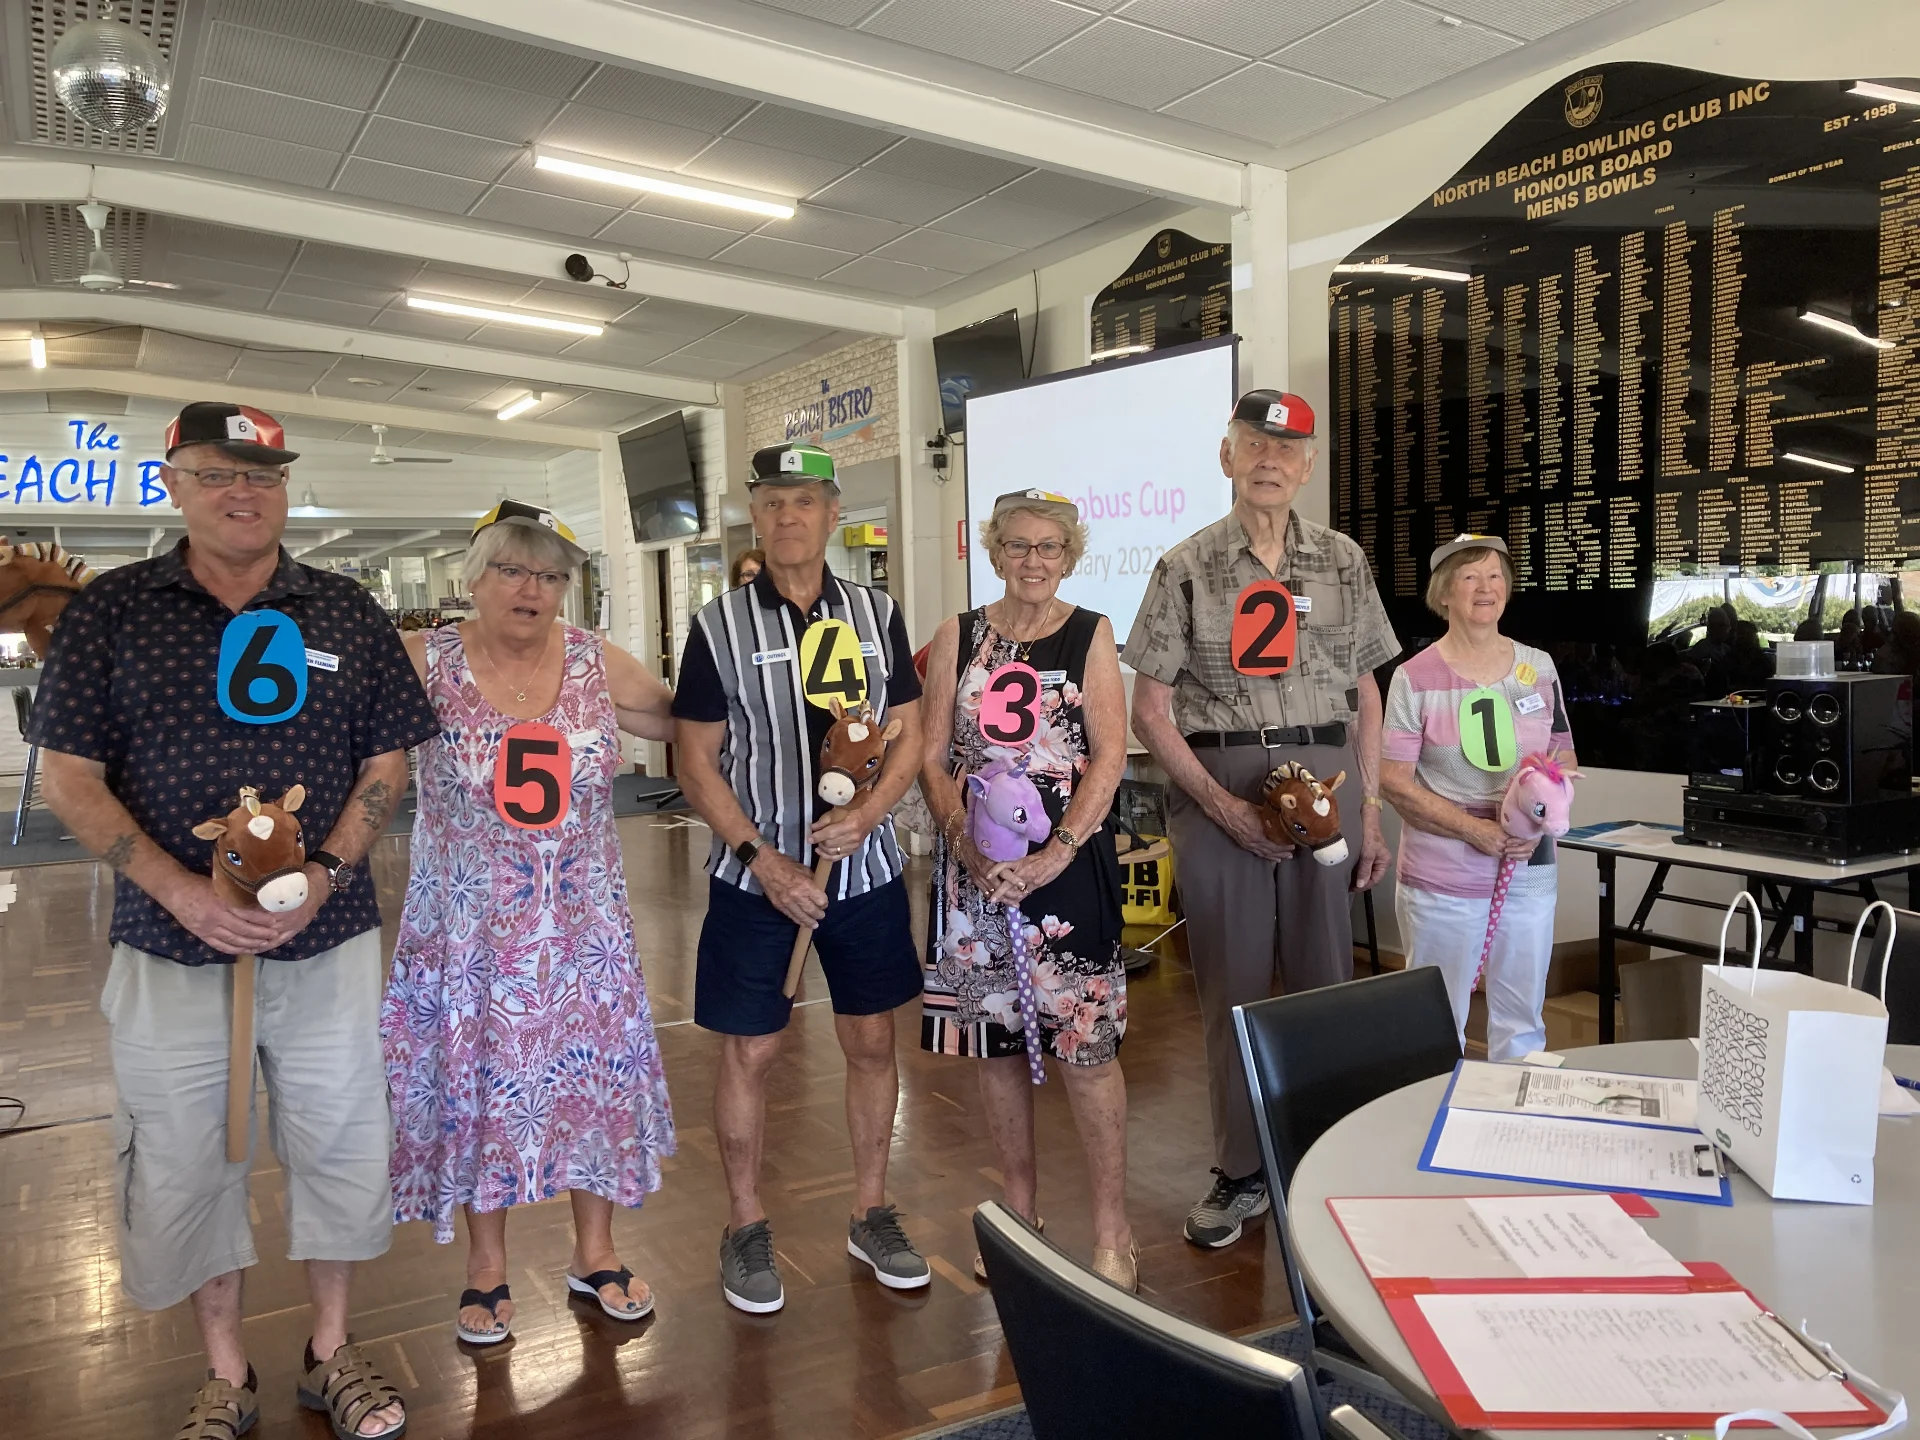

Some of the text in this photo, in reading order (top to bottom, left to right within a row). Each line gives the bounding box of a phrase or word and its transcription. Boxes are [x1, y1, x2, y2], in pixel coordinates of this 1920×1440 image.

[1823, 115, 1851, 133] EST
[1863, 102, 1897, 121] 1958
[1433, 81, 1771, 208] NORTH BEACH BOWLING CLUB INC
[1883, 140, 1914, 153] SPECIAL
[1513, 140, 1673, 204] HONOUR BOARD
[1768, 158, 1844, 184] BOWLER OF THE YEAR
[1526, 167, 1657, 221] MENS BOWLS
[1654, 204, 1675, 215] FOURS
[1112, 276, 1134, 290] NORTH
[1135, 268, 1156, 282] BEACH
[1157, 257, 1188, 274] BOWLING
[1190, 249, 1209, 263] CLUB
[1211, 244, 1225, 256] INC
[1370, 254, 1389, 265] 1958
[1145, 272, 1185, 290] HONOUR BOARD
[237, 420, 247, 434] 6
[784, 385, 873, 441] BEACH BISTRO
[1275, 409, 1282, 418] 2
[68, 420, 121, 451] The
[788, 456, 795, 465] 4
[1865, 463, 1897, 472] BOWLER
[1727, 476, 1749, 484] FOURS
[1053, 480, 1185, 525] obus Cup
[1238, 590, 1289, 668] 2
[228, 624, 299, 717] 6
[315, 660, 336, 669] FLEMING
[806, 626, 865, 702] 4
[984, 671, 1037, 742] 3
[1471, 698, 1501, 766] 1
[503, 738, 560, 825] 5
